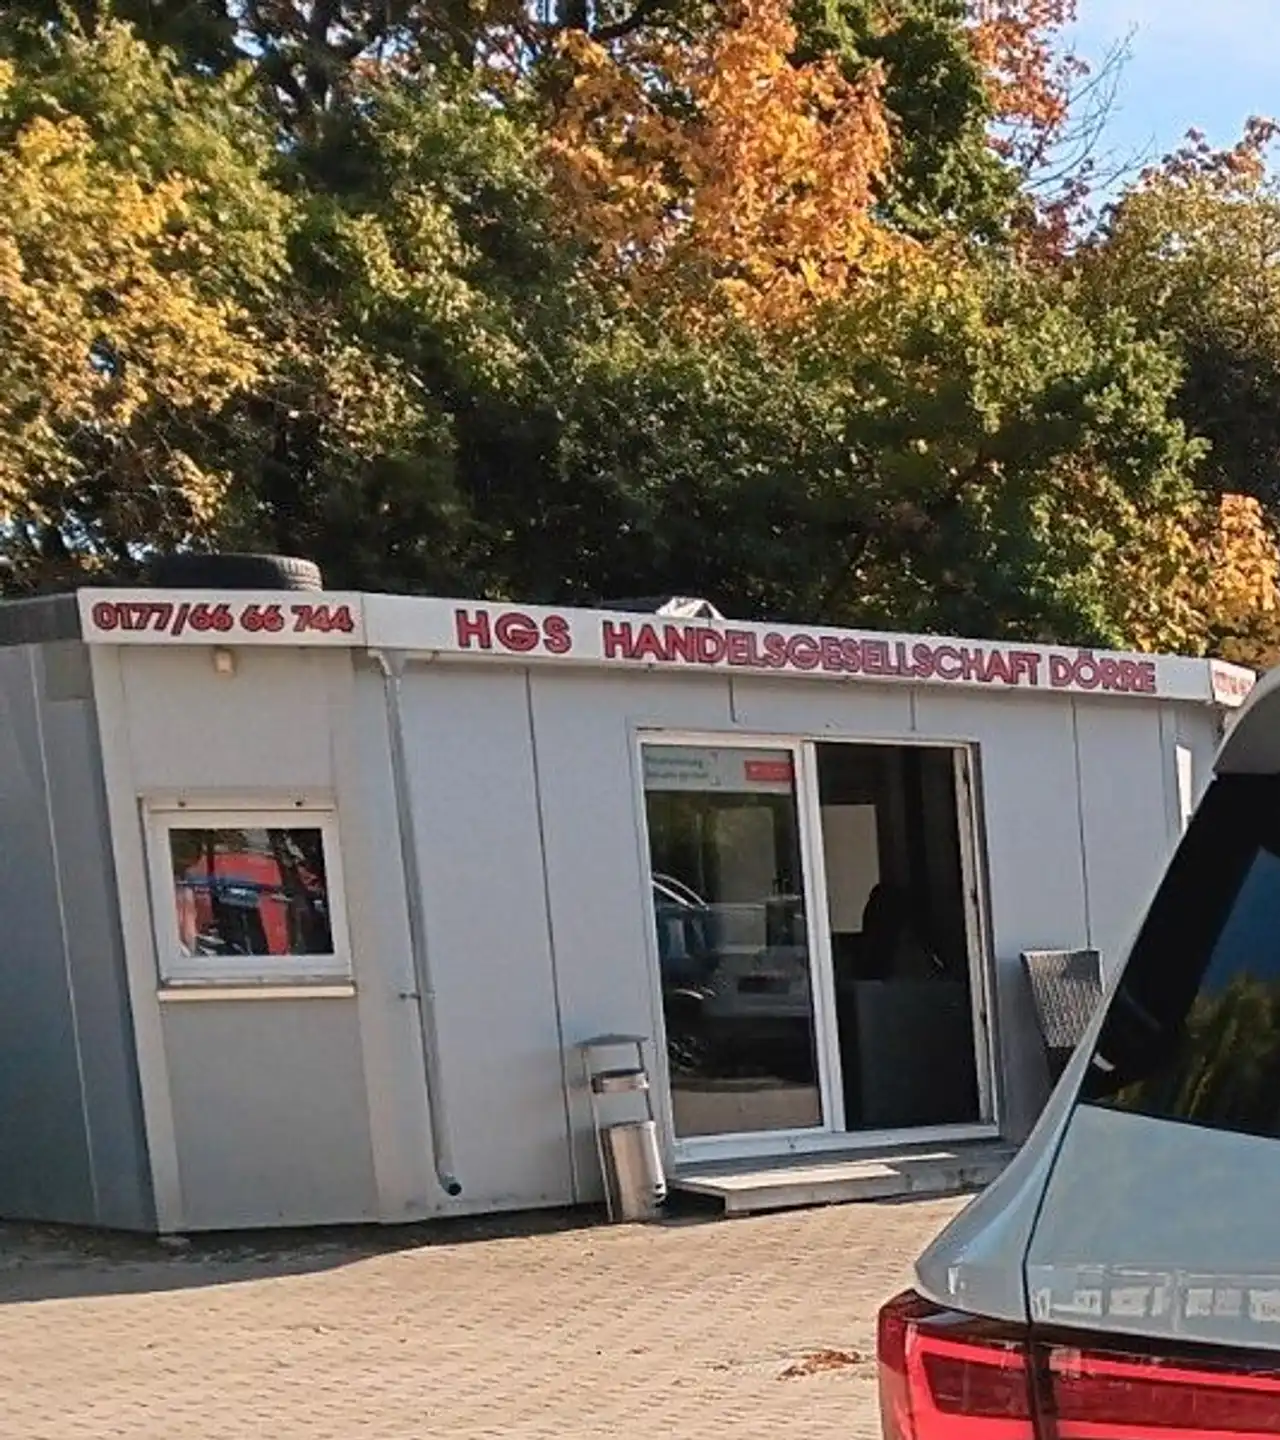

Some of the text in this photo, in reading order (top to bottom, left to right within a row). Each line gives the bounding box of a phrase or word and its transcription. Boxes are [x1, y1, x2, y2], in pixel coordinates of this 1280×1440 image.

[92, 602, 355, 636] 0177/66 66 744
[455, 609, 1159, 693] HGS HANDELSGESELLSCHAFT DÖRRE
